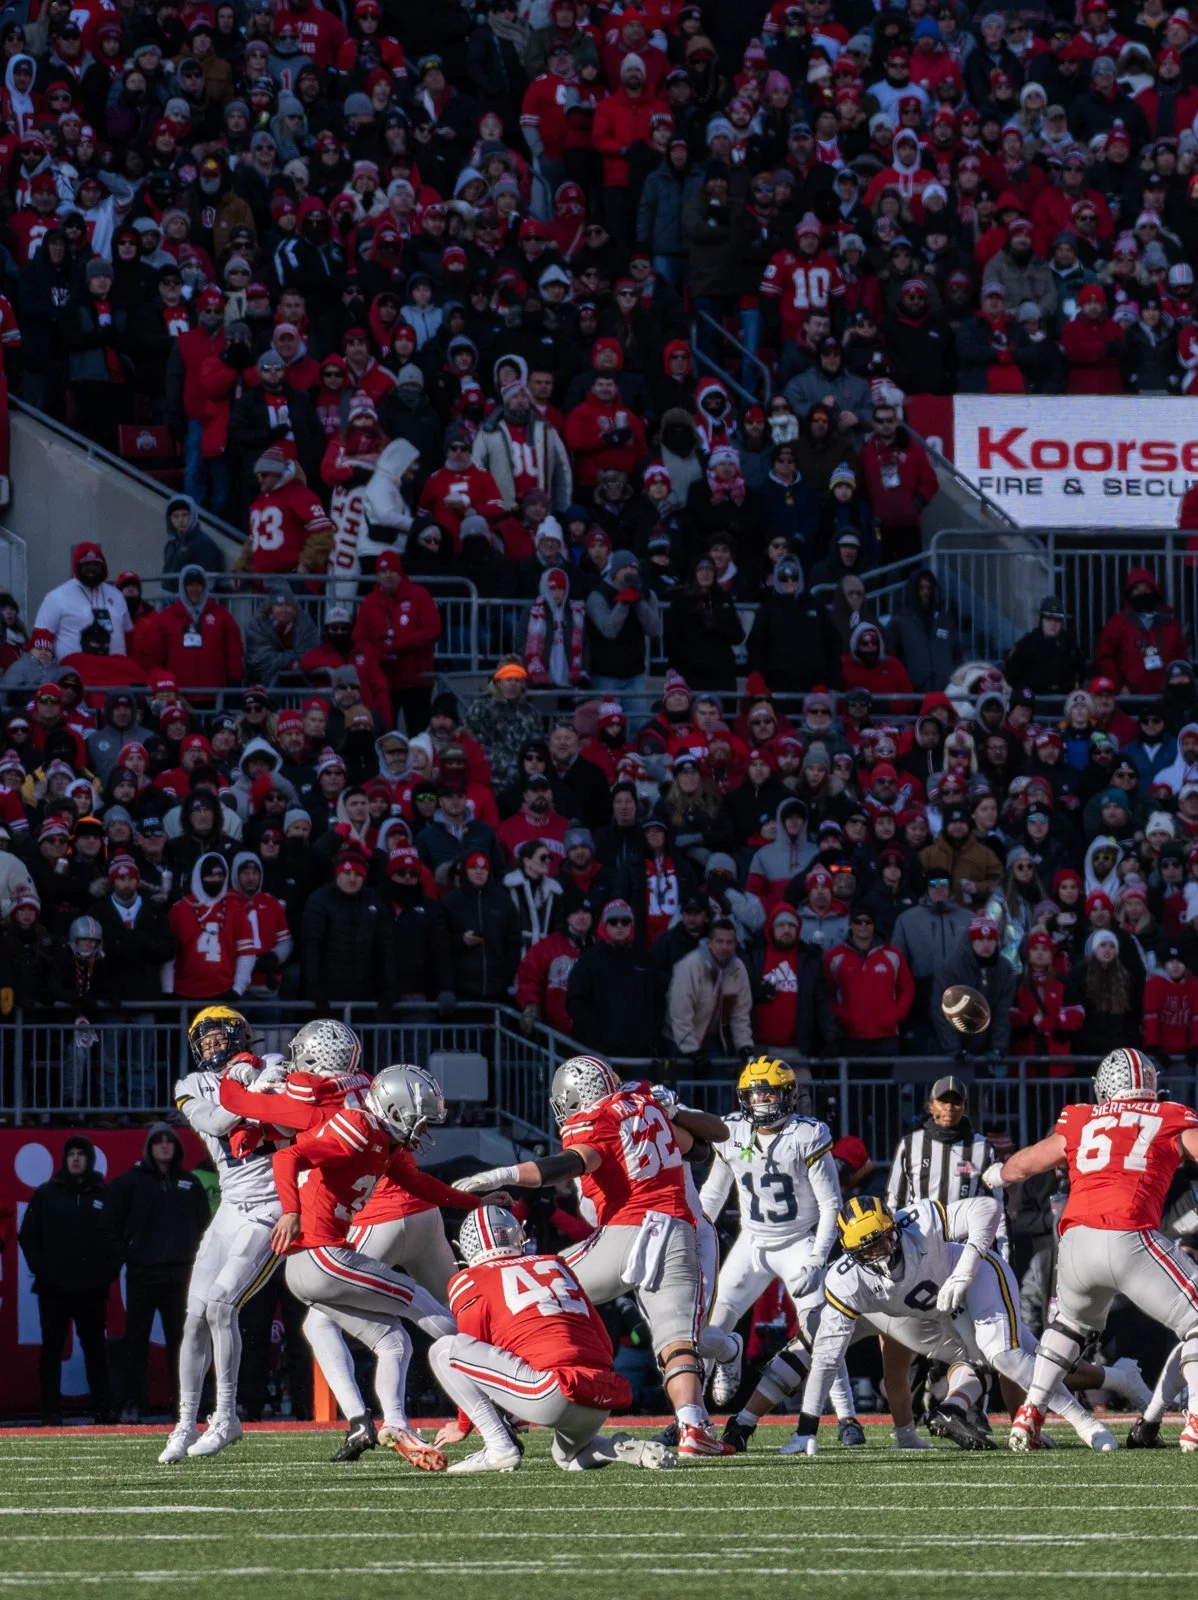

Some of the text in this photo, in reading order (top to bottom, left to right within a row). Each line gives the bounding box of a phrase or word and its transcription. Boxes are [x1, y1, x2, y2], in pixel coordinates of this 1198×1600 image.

[792, 266, 831, 305] 10
[979, 477, 1044, 496] FIRE
[1063, 478, 1085, 496] &
[196, 921, 222, 963] 4
[247, 908, 262, 950] 1
[620, 1104, 683, 1181] 62
[1076, 1110, 1164, 1174] 67
[741, 1171, 799, 1224] 13
[900, 1208, 920, 1228] 8
[500, 1260, 590, 1318] 42
